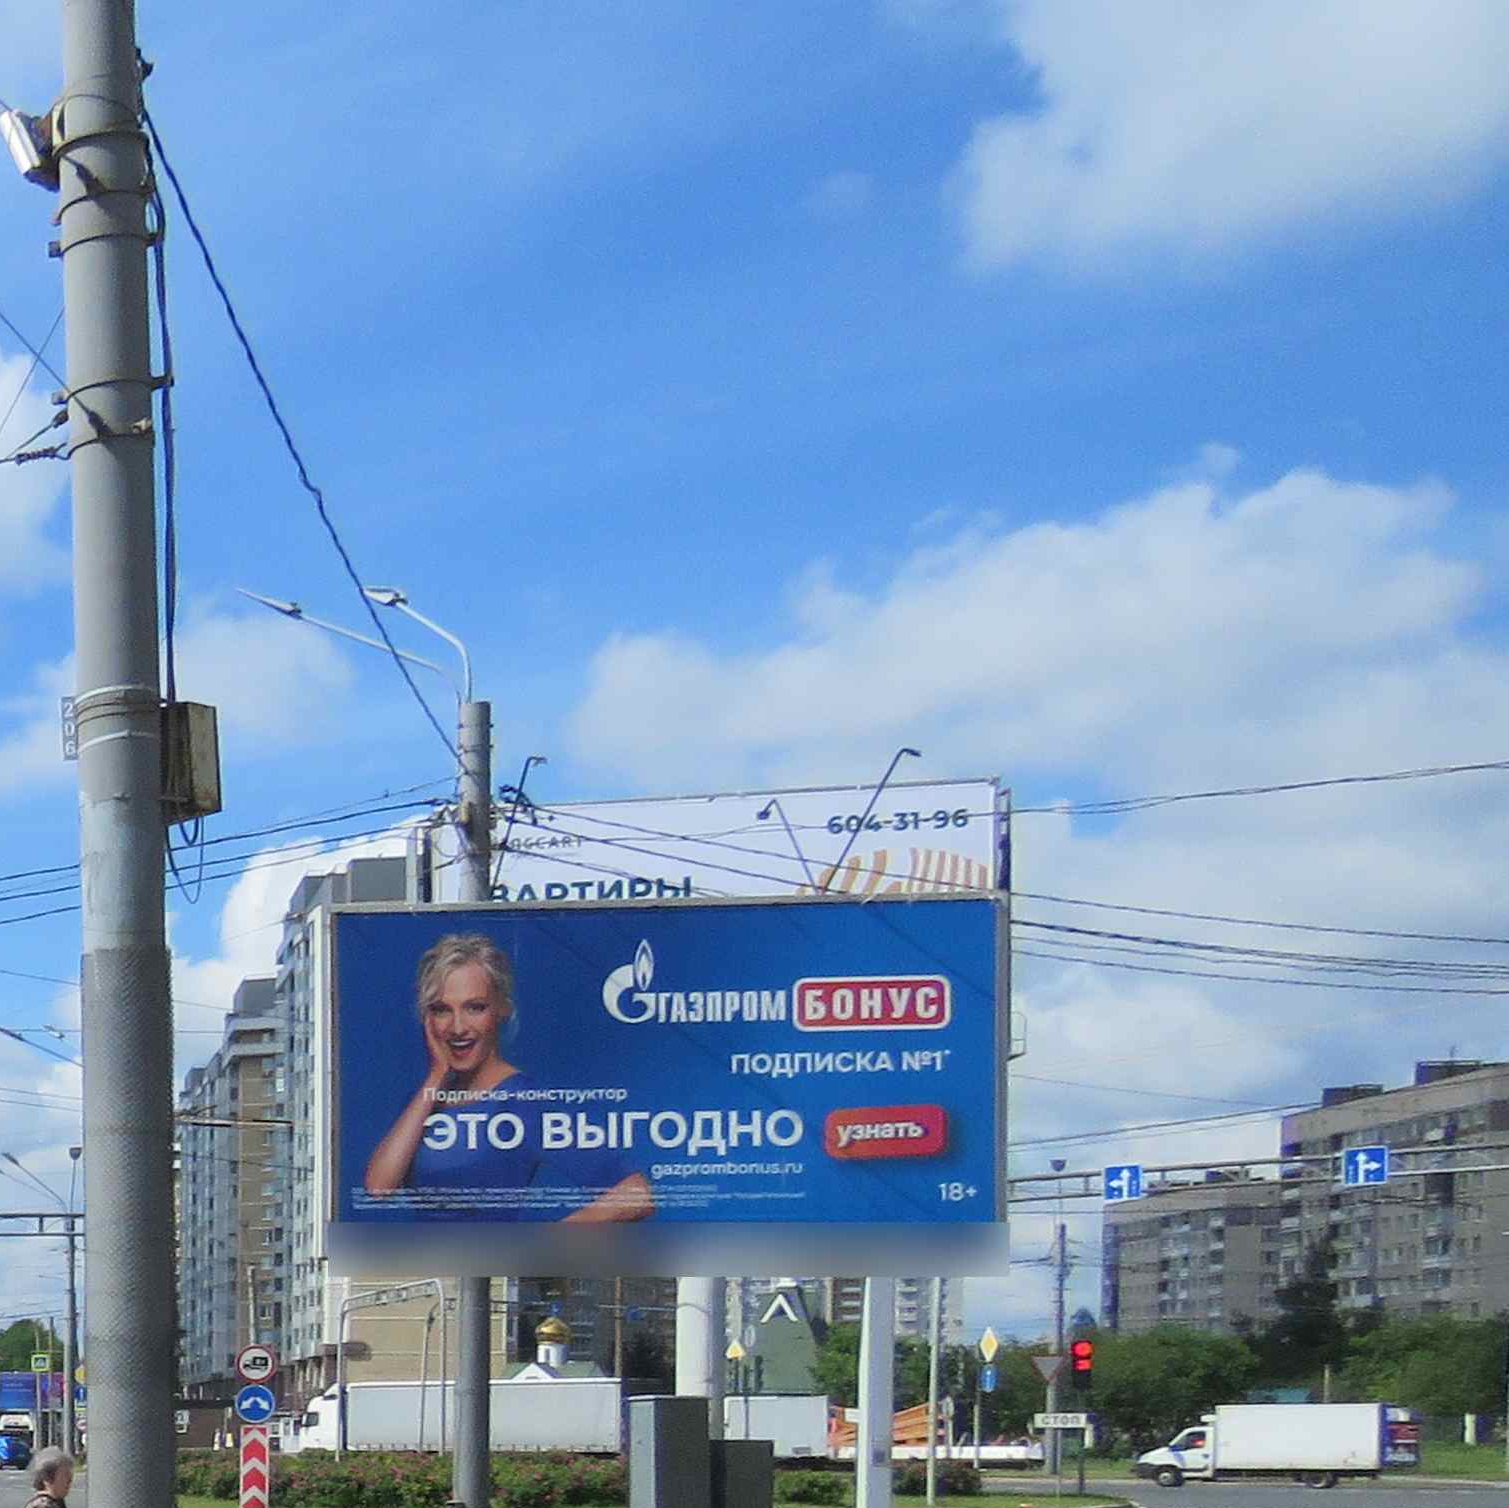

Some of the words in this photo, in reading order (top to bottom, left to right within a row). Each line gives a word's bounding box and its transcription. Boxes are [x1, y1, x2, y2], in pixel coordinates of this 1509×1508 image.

[827, 809, 969, 835] 604-31-96
[489, 876, 692, 903] ВАРТИРЫ
[655, 990, 787, 1023] ГАЗПРОМ
[803, 987, 939, 1021] БОНУС
[731, 1051, 895, 1078] ПОДПИСКА
[422, 1087, 628, 1103] Подписка-конструктор
[422, 1111, 526, 1151] ЭТО
[541, 1109, 805, 1156] ВЫГОДНО
[835, 1121, 925, 1149] узнать
[650, 1161, 804, 1180] gazprombonus.ru
[937, 1182, 978, 1202] 18+
